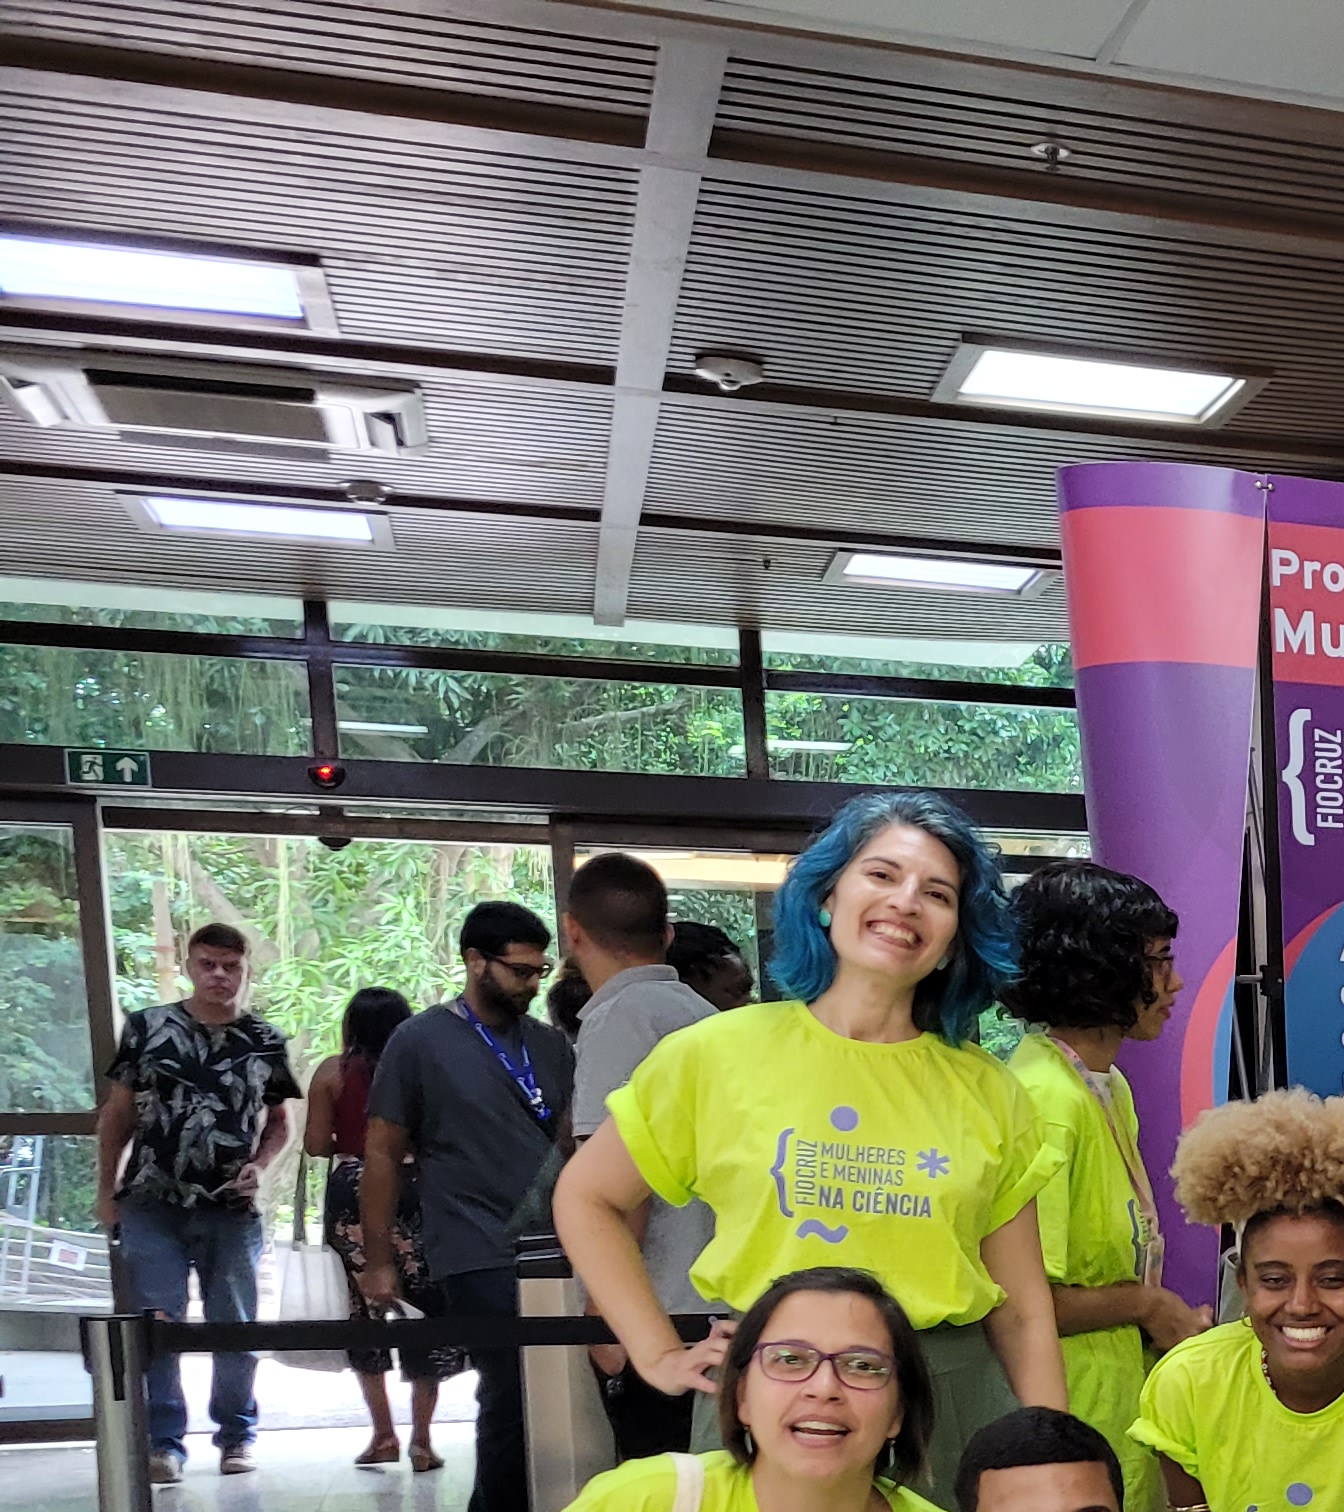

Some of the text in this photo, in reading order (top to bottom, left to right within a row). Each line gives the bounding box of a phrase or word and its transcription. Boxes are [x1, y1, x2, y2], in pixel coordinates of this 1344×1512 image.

[1313, 728, 1344, 829] FIOCRUZ
[820, 1141, 906, 1165] MULHERES
[795, 1139, 818, 1206] FIOCRUZ
[820, 1161, 904, 1186] E MENINAS
[819, 1187, 932, 1218] NA CIÊNCIA
